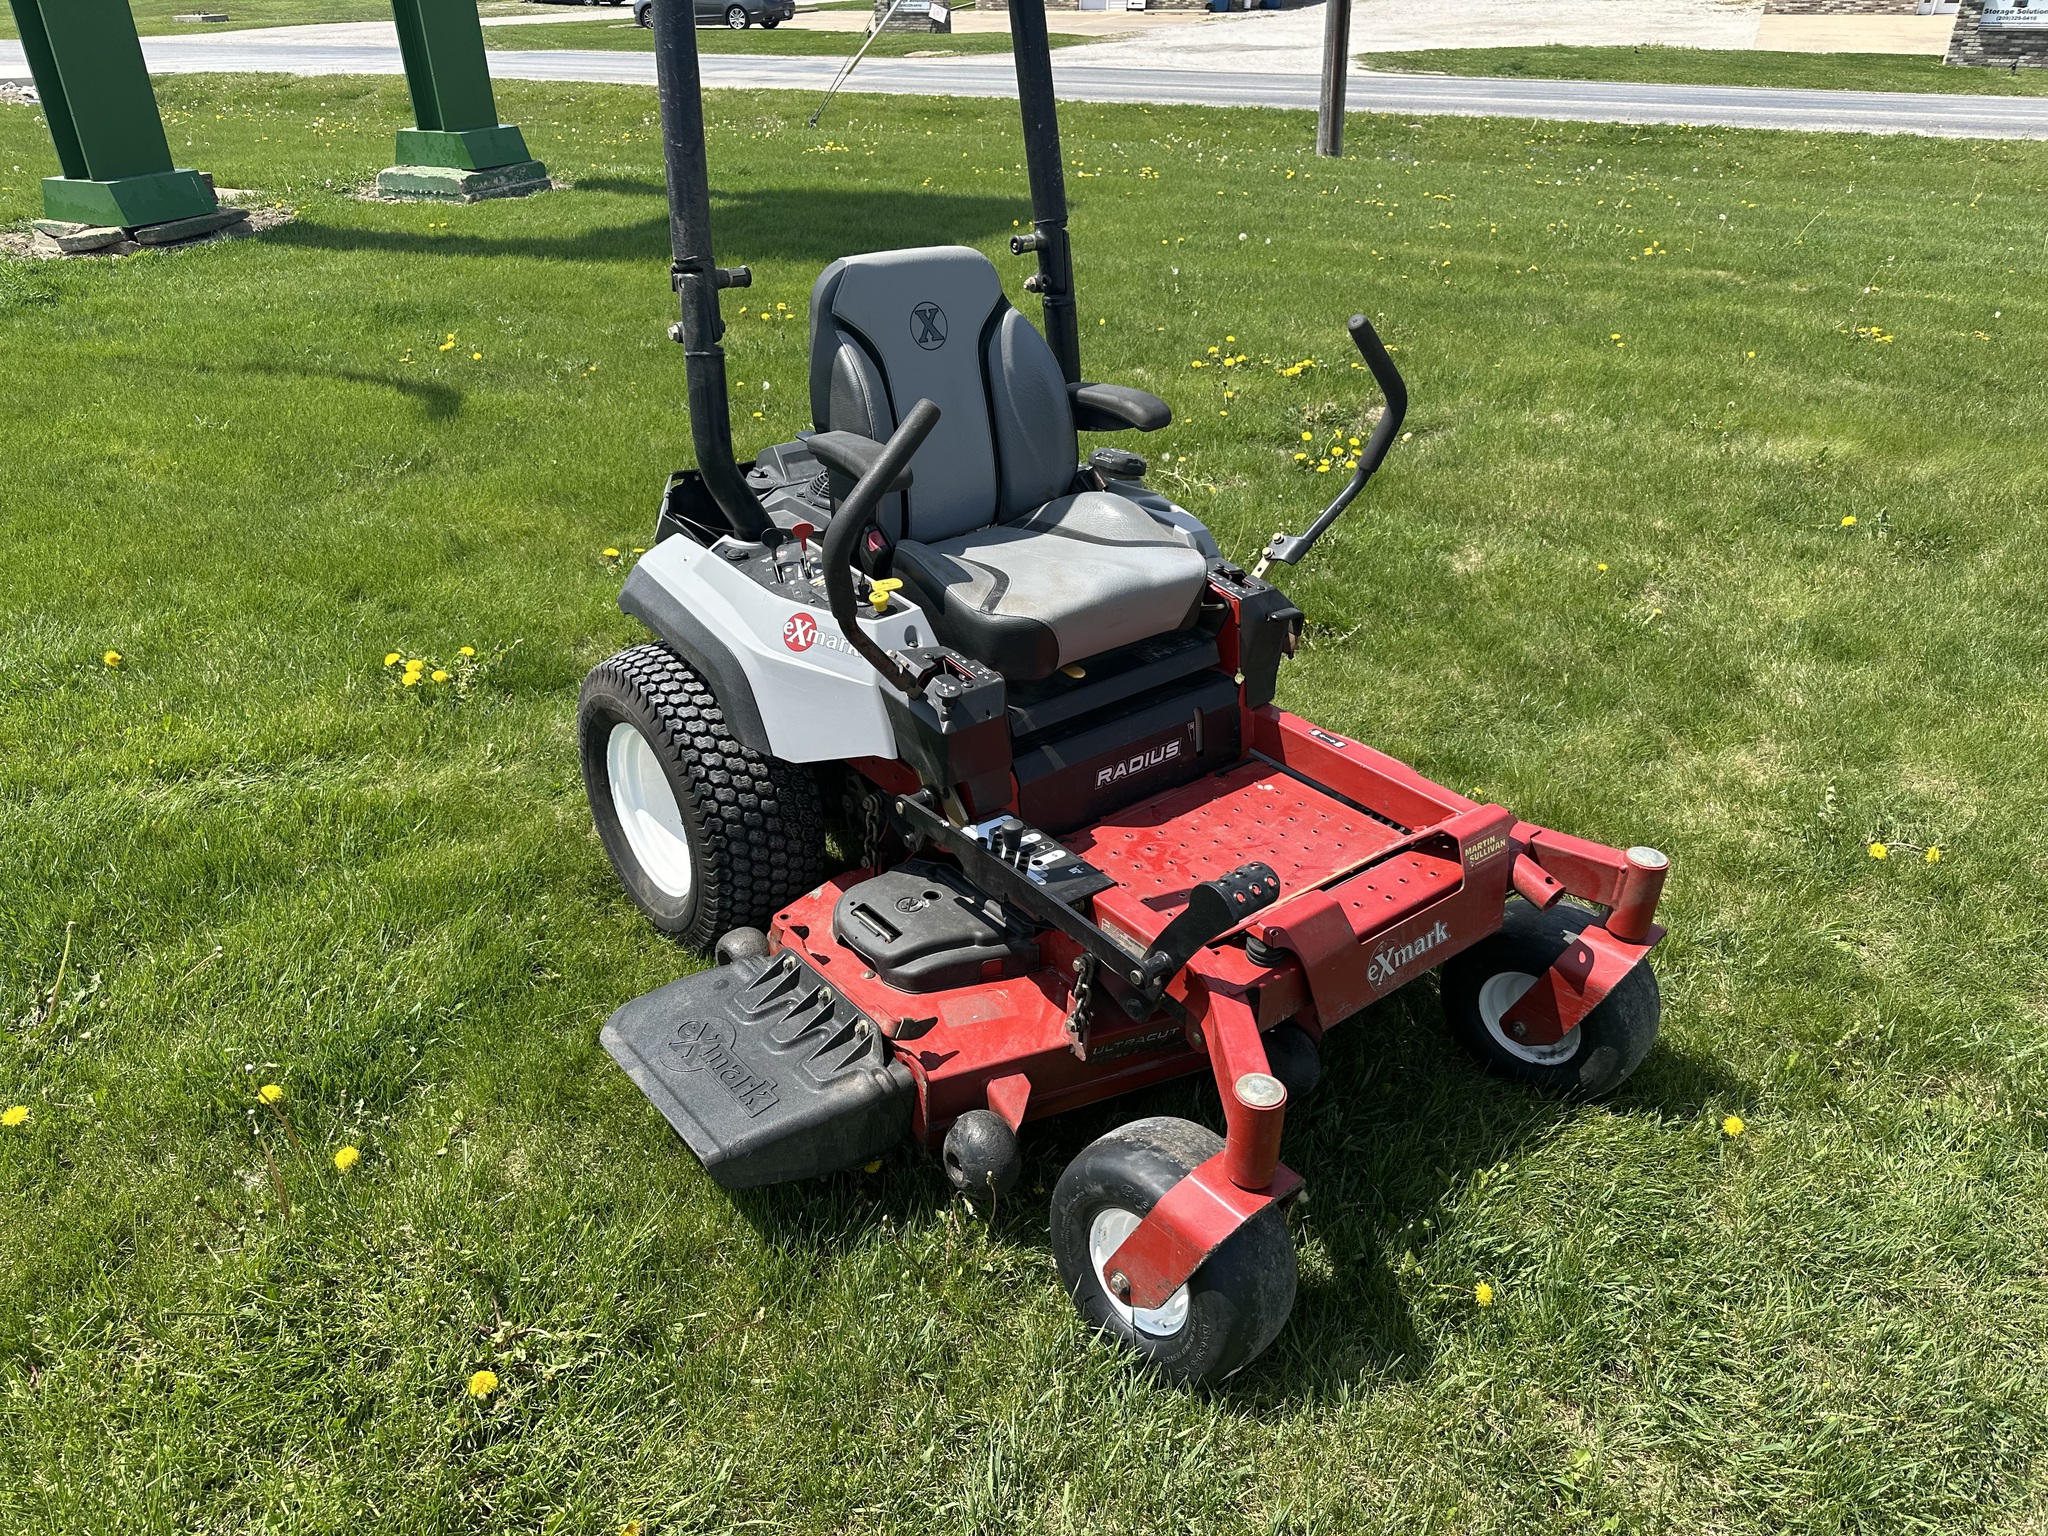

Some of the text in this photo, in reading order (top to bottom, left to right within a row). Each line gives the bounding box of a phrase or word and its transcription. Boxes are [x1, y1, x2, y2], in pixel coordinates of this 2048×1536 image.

[1983, 8, 2015, 16] Storage
[914, 308, 945, 343] X
[1096, 739, 1181, 788] RADIUS
[1464, 835, 1496, 857] MARTIN
[1469, 839, 1506, 863] SULLIVAN
[1367, 919, 1449, 986] eXmark
[1092, 1027, 1180, 1056] ULTRACUT
